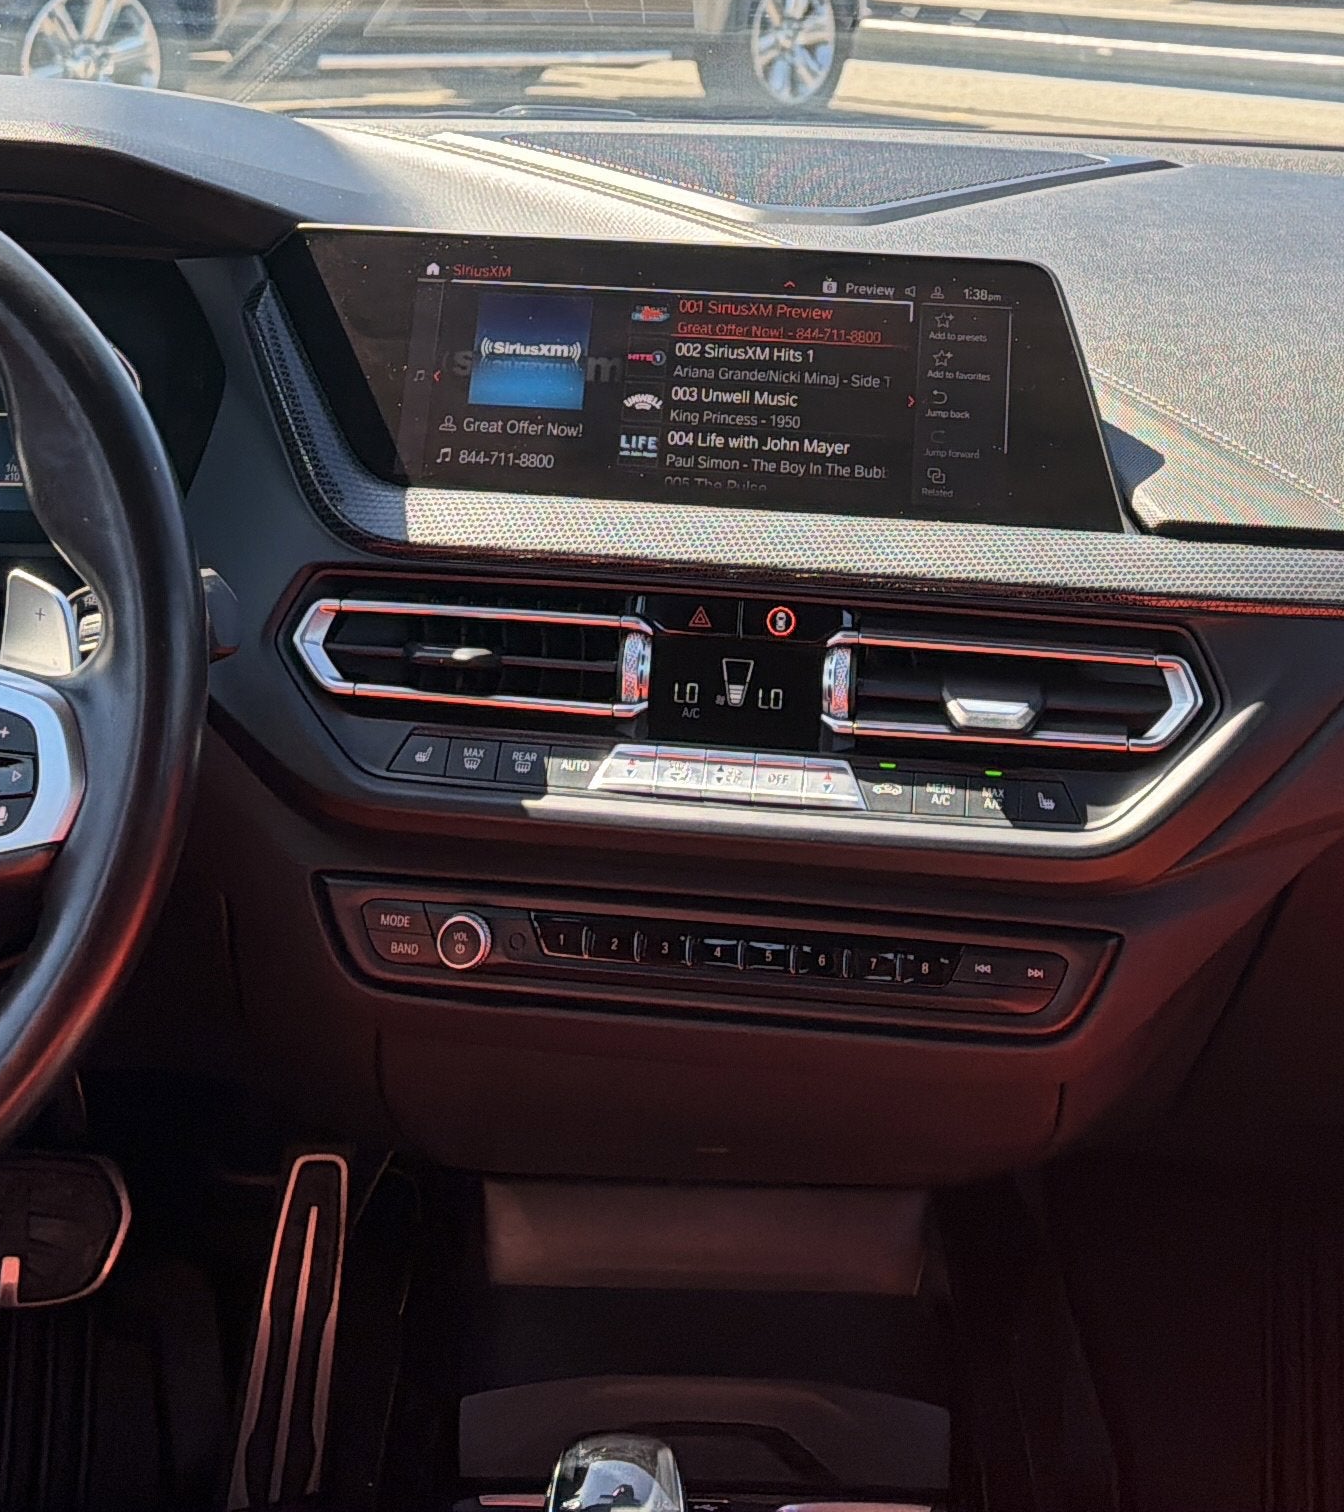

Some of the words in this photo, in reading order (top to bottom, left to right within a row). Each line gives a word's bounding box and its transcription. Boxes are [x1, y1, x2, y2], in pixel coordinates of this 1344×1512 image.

[453, 264, 512, 278] SiriusXM
[846, 283, 895, 297] Preview
[679, 300, 703, 314] 001
[708, 301, 772, 317] SiriusXM
[777, 304, 834, 320] Preview
[678, 321, 713, 336] Great
[716, 323, 748, 337] Offer
[752, 325, 784, 339] Now!
[796, 327, 882, 345] 844-711-8800
[929, 331, 946, 340] Add
[947, 332, 955, 341] to
[958, 333, 988, 343] presets
[675, 342, 701, 358] 002
[704, 344, 770, 361] SiriusXM
[773, 347, 803, 363] Hits
[807, 349, 814, 363] 1
[673, 365, 715, 380] Ariana
[718, 367, 800, 385] Grande/Nicki
[804, 370, 840, 389] Minaj
[851, 374, 880, 389] Side
[927, 369, 944, 379] Add
[946, 370, 954, 379] to
[956, 371, 991, 383] favorites
[671, 387, 698, 402] 003
[701, 388, 751, 405] Unwell
[754, 391, 799, 408] Music
[669, 409, 699, 426] King
[703, 411, 758, 427] Princess
[770, 414, 801, 429] 1950
[925, 408, 948, 420] Jump
[950, 409, 970, 419] back
[463, 417, 503, 434] Great
[506, 419, 543, 437] Offer
[547, 422, 583, 438] Now!
[620, 434, 658, 450] LIFE
[667, 431, 694, 446] 004
[697, 432, 725, 448] Life
[728, 434, 758, 450] with
[762, 437, 800, 453] John
[803, 439, 851, 457] Mayer
[459, 449, 554, 469] 844-711-8800
[665, 454, 695, 469] Paul
[697, 455, 740, 471] Simon
[751, 458, 777, 473] The
[780, 460, 806, 478] Boy
[809, 462, 822, 476] In
[825, 463, 851, 478] The
[674, 683, 698, 704] LO
[758, 689, 783, 710] LO
[682, 707, 700, 719] A/C
[463, 747, 485, 758] MAX
[512, 751, 538, 762] REAR
[560, 759, 590, 772] AUTO
[768, 773, 789, 784] OFF
[926, 782, 956, 795] MENU
[982, 787, 1005, 799] MAX
[931, 794, 951, 806] A/C
[984, 797, 1003, 810] A/C
[380, 914, 411, 927] MODE
[453, 931, 468, 941] VOL
[559, 934, 564, 945] 1
[391, 942, 418, 955] BAND
[611, 938, 618, 950] 2
[661, 942, 669, 954] 3
[713, 946, 721, 958] 4
[765, 950, 773, 962] 5
[818, 954, 826, 967] 6
[870, 958, 877, 970] 7
[921, 962, 929, 975] 8
